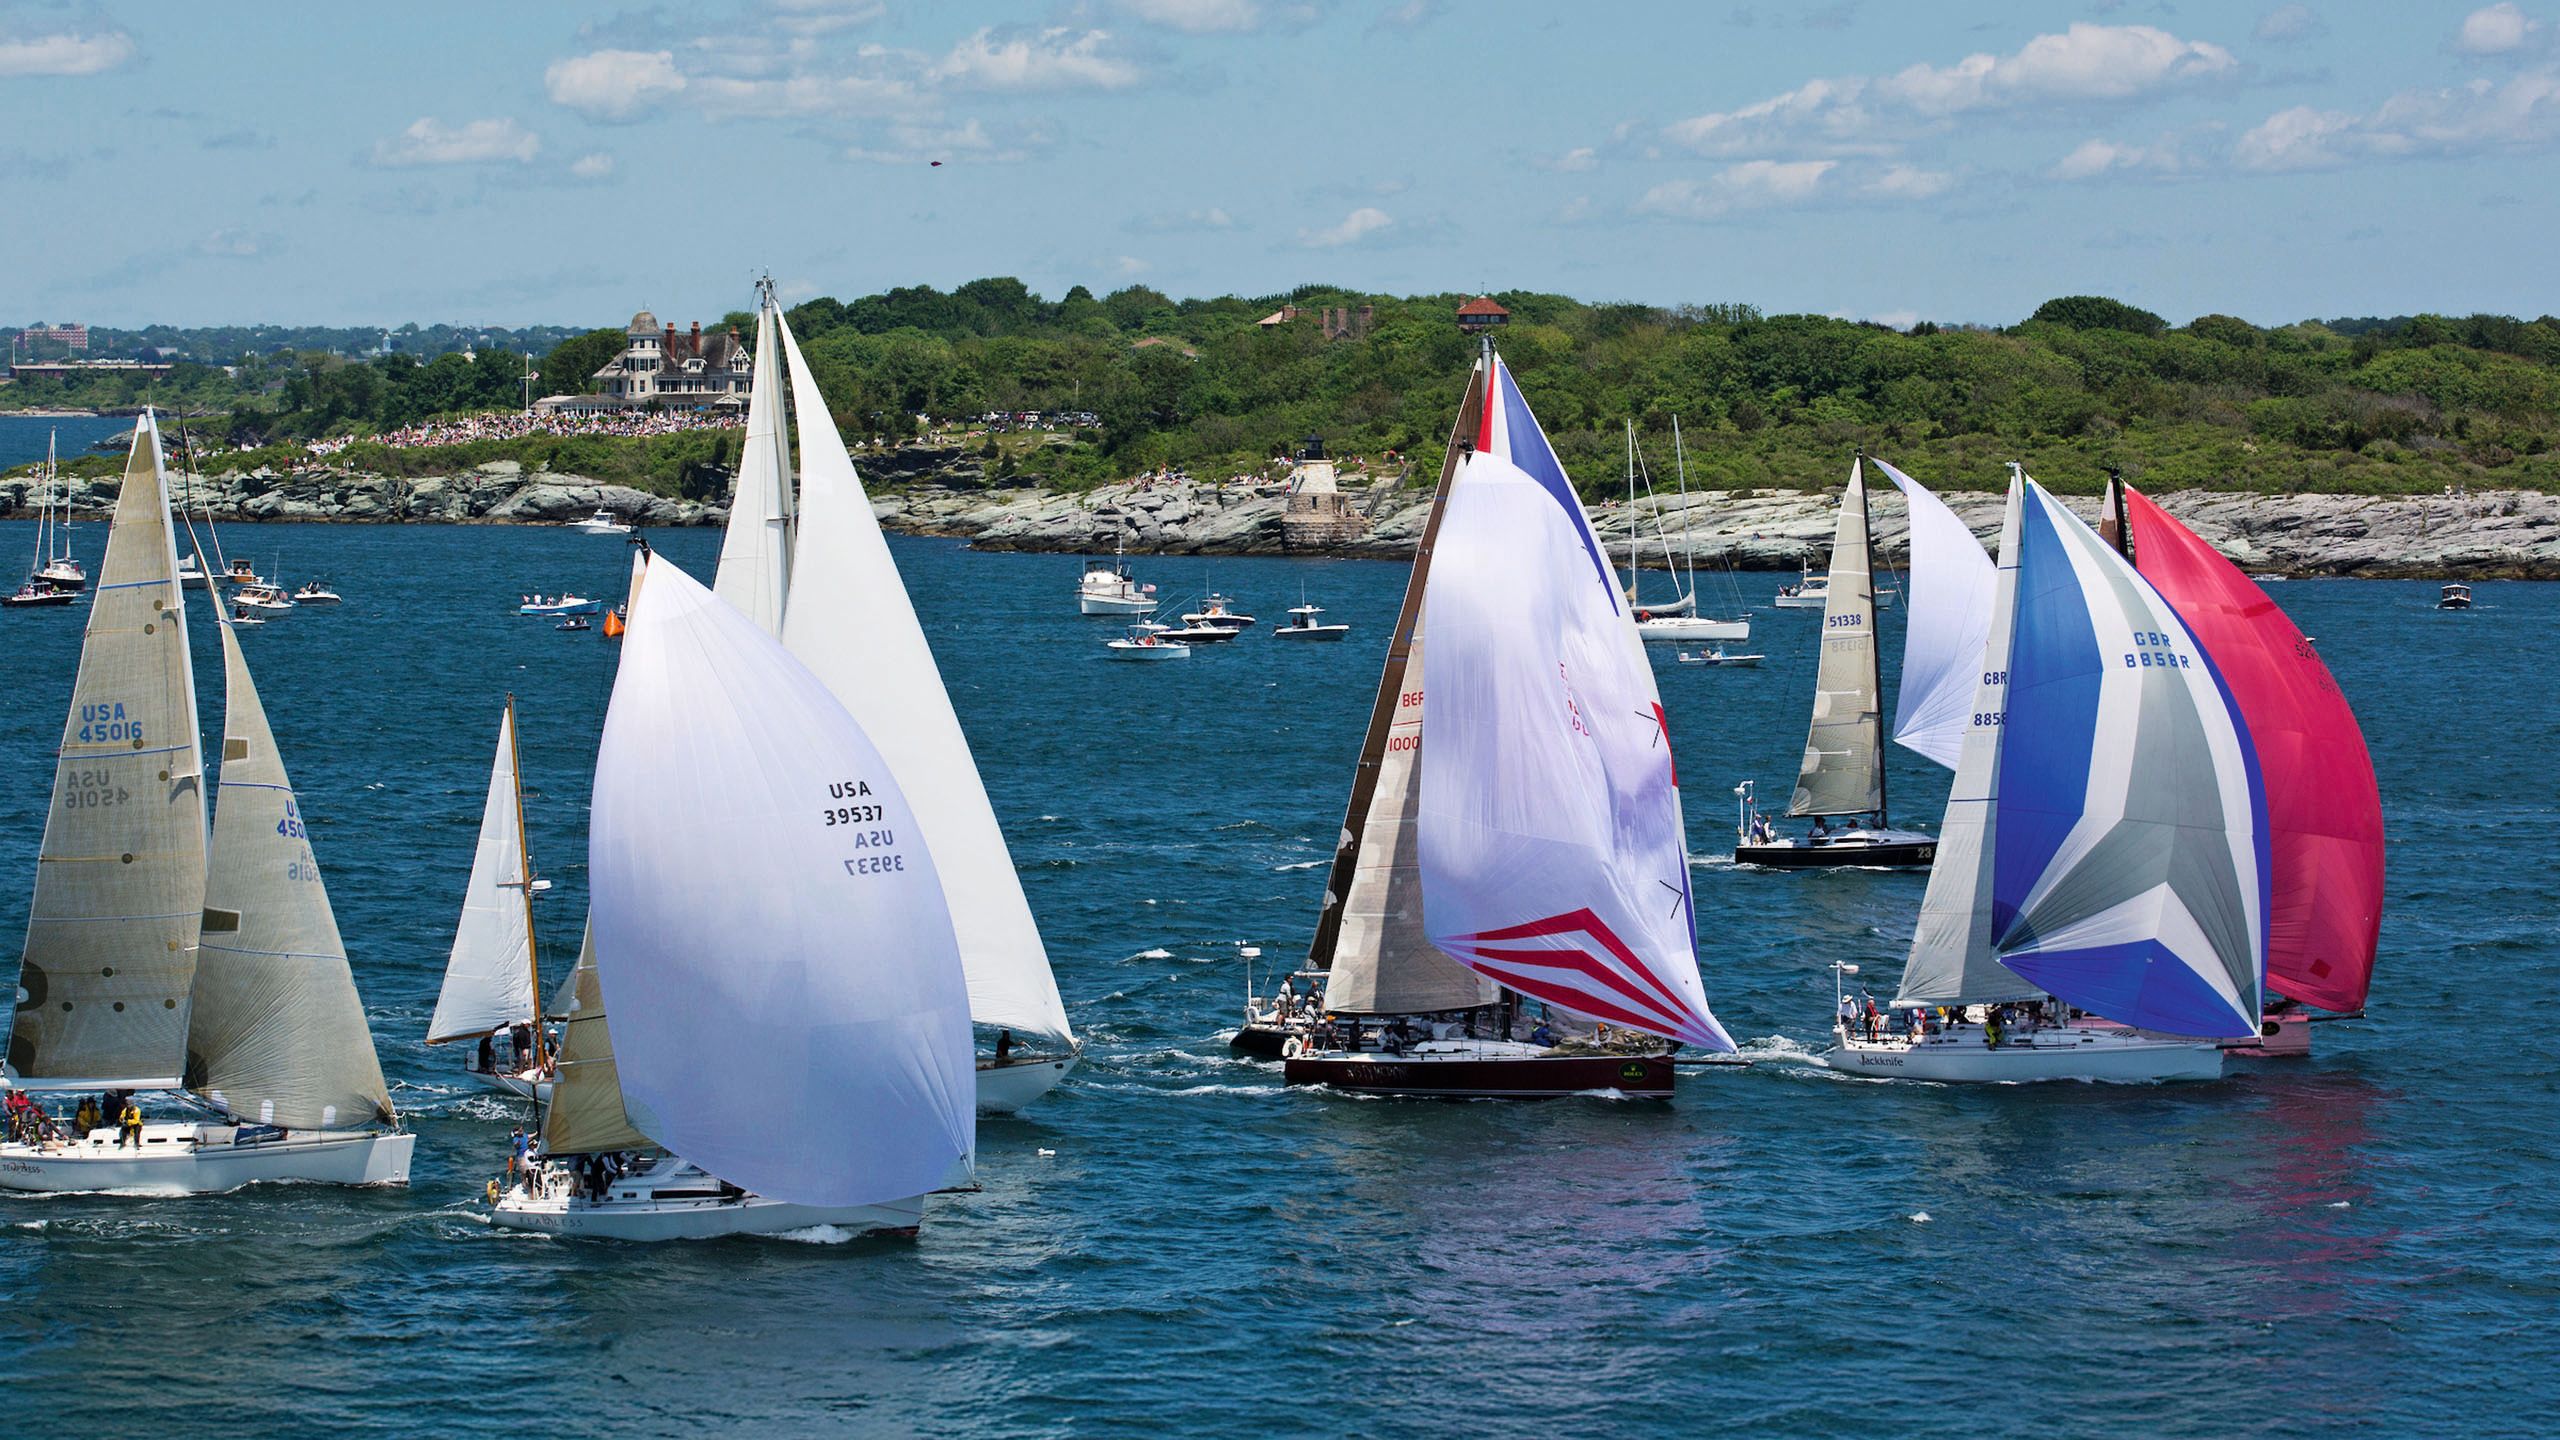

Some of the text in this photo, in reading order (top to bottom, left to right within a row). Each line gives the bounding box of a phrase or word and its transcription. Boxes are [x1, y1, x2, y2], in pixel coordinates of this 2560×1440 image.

[1829, 614, 1862, 627] 51338
[2134, 631, 2171, 647] GBR
[2125, 652, 2190, 669] 8858R
[1984, 671, 2008, 685] GBR
[82, 702, 126, 722] USA
[79, 721, 143, 742] 45016
[1389, 736, 1420, 751] 1000
[828, 780, 872, 799] USA
[824, 805, 882, 826] 39537
[1917, 847, 1932, 858] 23
[1857, 1054, 1904, 1067] Jackknife
